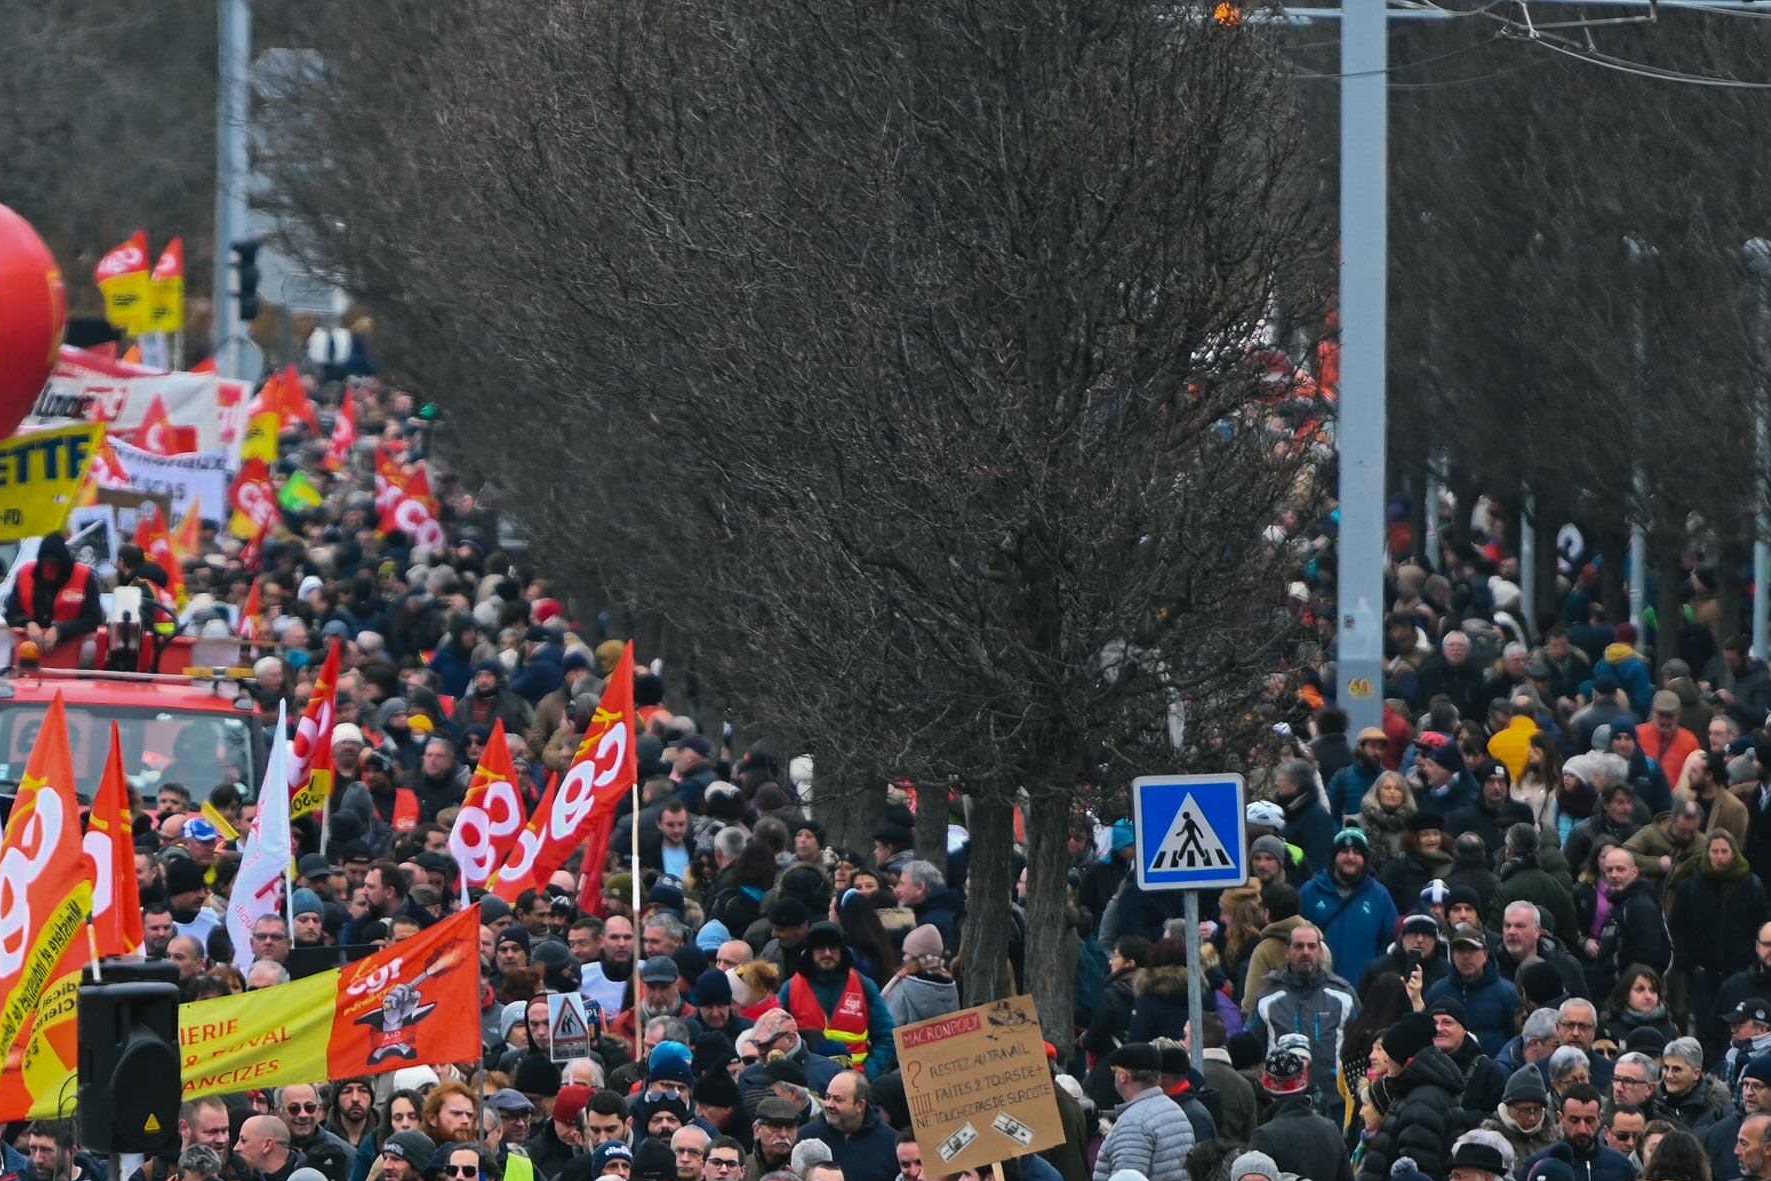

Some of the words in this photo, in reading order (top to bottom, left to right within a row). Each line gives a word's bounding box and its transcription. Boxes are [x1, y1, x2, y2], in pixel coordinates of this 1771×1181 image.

[346, 957, 404, 996] cgt
[180, 1018, 238, 1047] IERIE
[903, 1015, 978, 1044] MACRONPOLY
[182, 1059, 279, 1093] ANCIZES
[930, 1056, 972, 1079] RESTEZ
[975, 1080, 982, 1091] 2
[985, 1071, 1019, 1089] TOURS
[916, 1117, 930, 1129] NE
[934, 1107, 975, 1125] TOUCHEZ
[975, 1100, 992, 1113] PAS
[993, 1096, 1006, 1108] DE
[1007, 1083, 1052, 1105] SURCOTE
